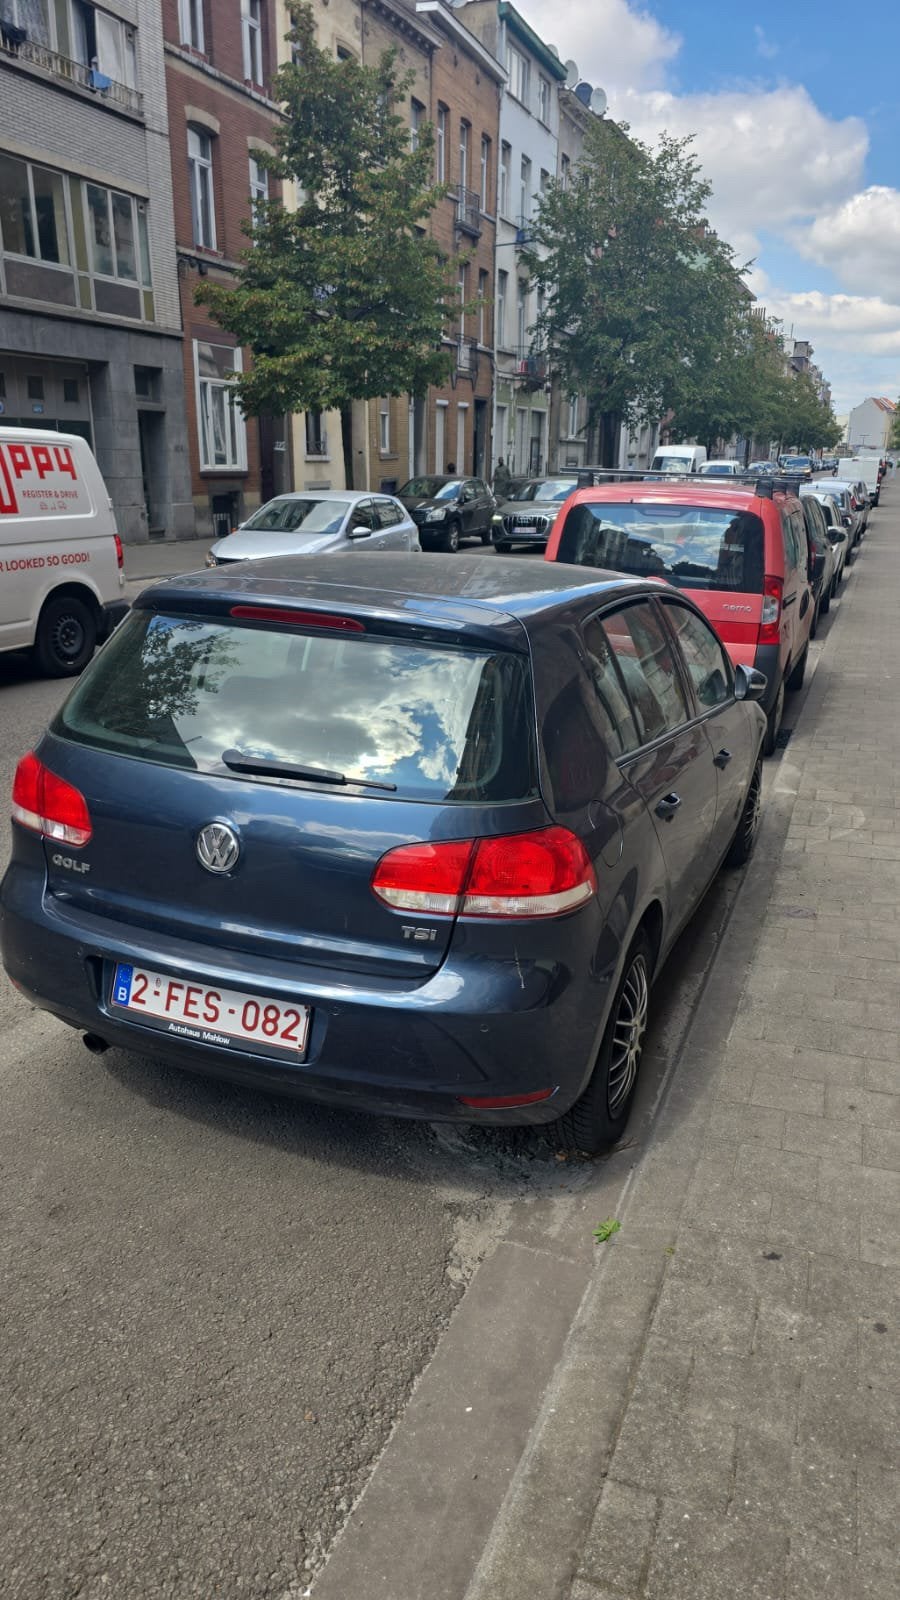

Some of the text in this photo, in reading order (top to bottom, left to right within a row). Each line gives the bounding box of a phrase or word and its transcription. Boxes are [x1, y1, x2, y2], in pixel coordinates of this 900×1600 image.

[22, 489, 79, 499] REGISTER & DRIVE
[5, 557, 45, 571] LOOKED
[47, 555, 60, 567] SO
[61, 552, 90, 565] GOOD!
[53, 853, 91, 874] GOLF
[118, 973, 301, 1042] B 2-FES-082
[168, 1023, 230, 1045] Autohaus Mahlow
